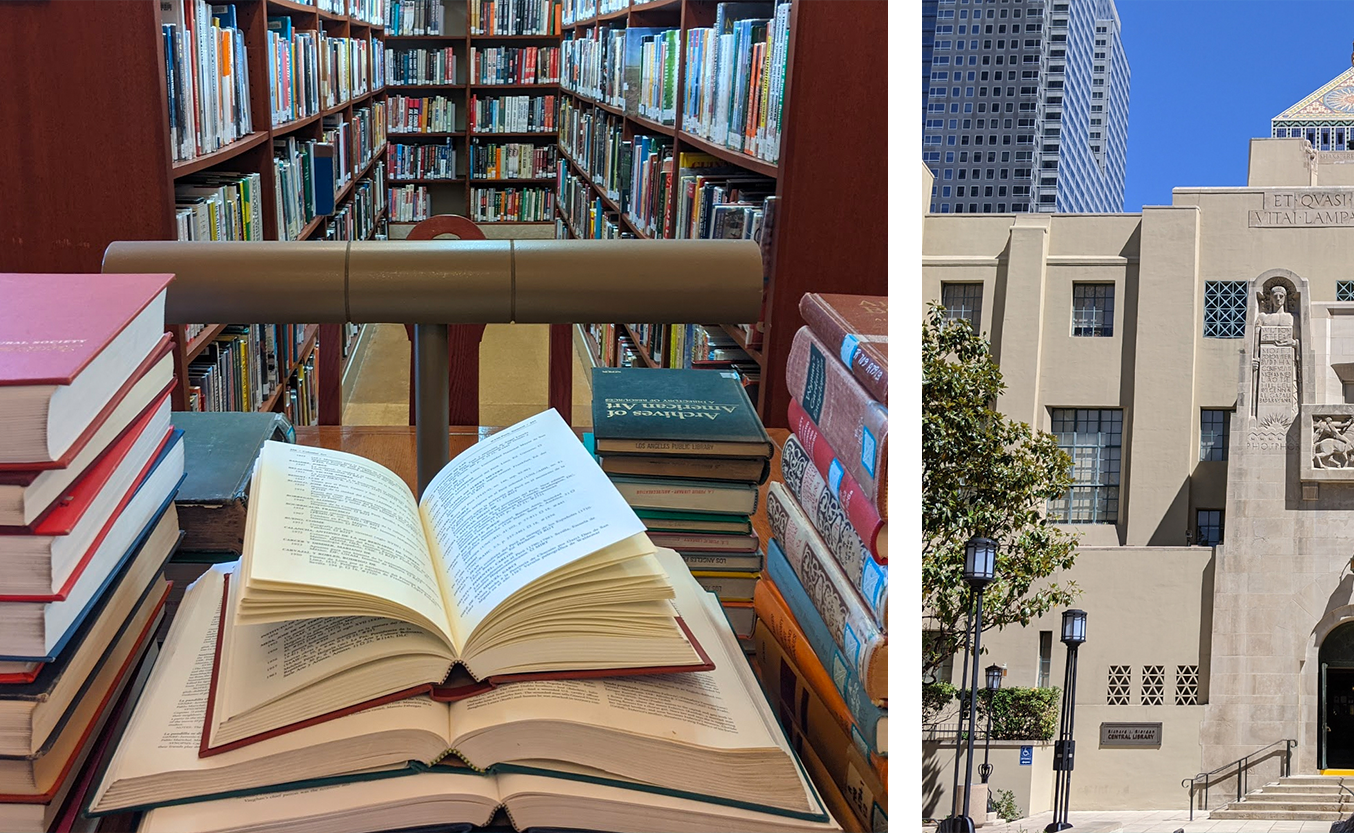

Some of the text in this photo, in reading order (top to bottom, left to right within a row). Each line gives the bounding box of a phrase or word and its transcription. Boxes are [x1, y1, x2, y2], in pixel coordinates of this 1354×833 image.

[1274, 195, 1294, 207] ET
[1301, 194, 1346, 209] QVASI
[1255, 211, 1297, 224] VITAI
[607, 403, 738, 414] American Art
[607, 409, 720, 420] Archives of
